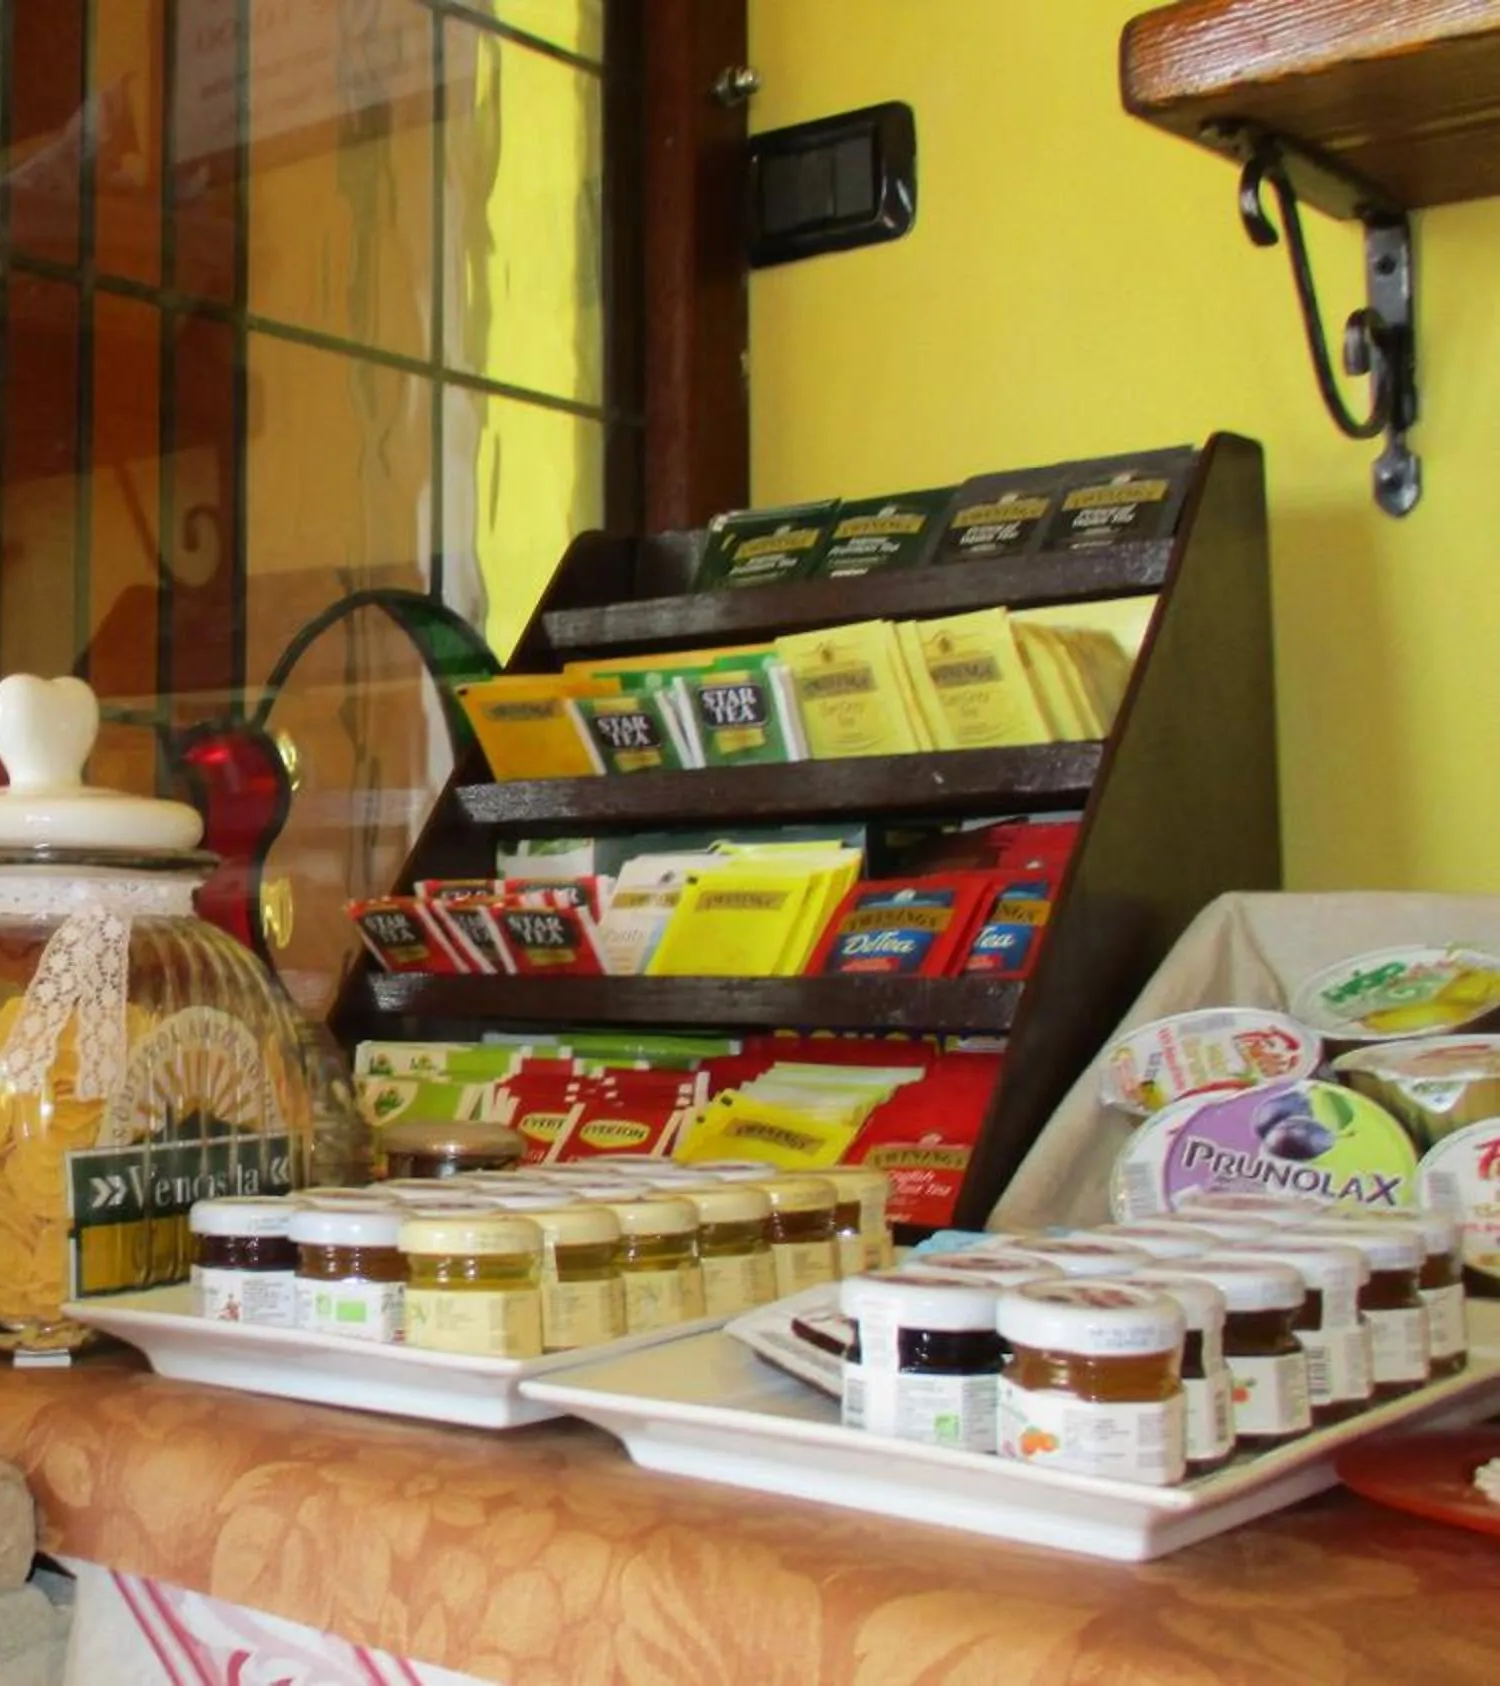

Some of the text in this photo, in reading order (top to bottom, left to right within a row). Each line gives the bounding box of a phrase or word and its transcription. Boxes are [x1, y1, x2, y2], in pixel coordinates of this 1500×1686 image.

[701, 686, 756, 707] STAR
[713, 703, 754, 723] TEA
[597, 715, 649, 736] STAR
[611, 729, 650, 747] TEA
[364, 914, 411, 930] STAR
[508, 915, 564, 932] STAR
[525, 930, 564, 945] TEA
[1185, 1141, 1402, 1207] PRUNOLAX
[128, 1163, 260, 1213] Venosta
